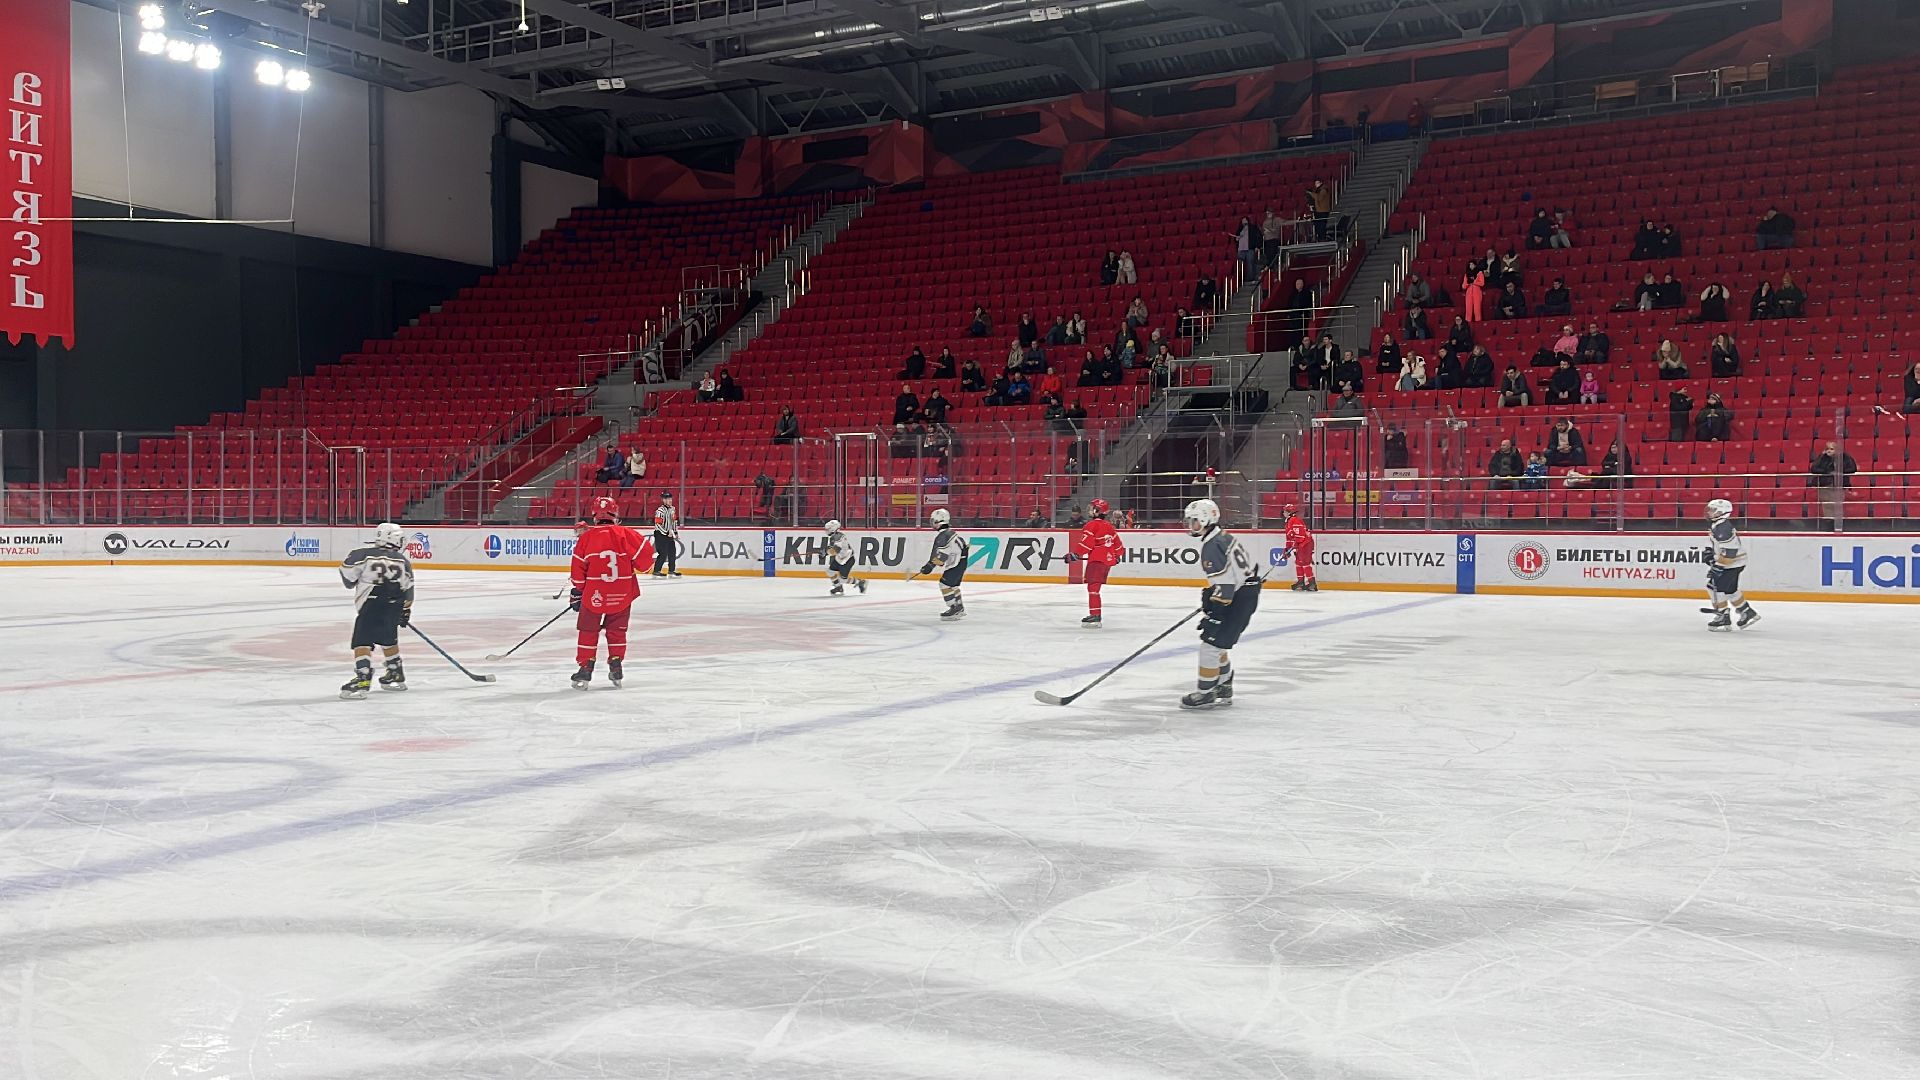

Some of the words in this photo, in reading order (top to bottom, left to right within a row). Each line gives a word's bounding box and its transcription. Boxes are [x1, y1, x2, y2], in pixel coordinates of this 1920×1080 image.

[9, 71, 45, 309] ВИТЯЗЬ
[14, 534, 63, 545] ОНЛАЙН
[132, 539, 230, 549] VALDAI
[505, 535, 577, 560] севернефтег
[690, 541, 750, 559] LADA
[1556, 549, 1631, 563] БИЛЕТЫ
[599, 549, 618, 583] 3
[1583, 567, 1676, 580] HCVITYAZ.RU
